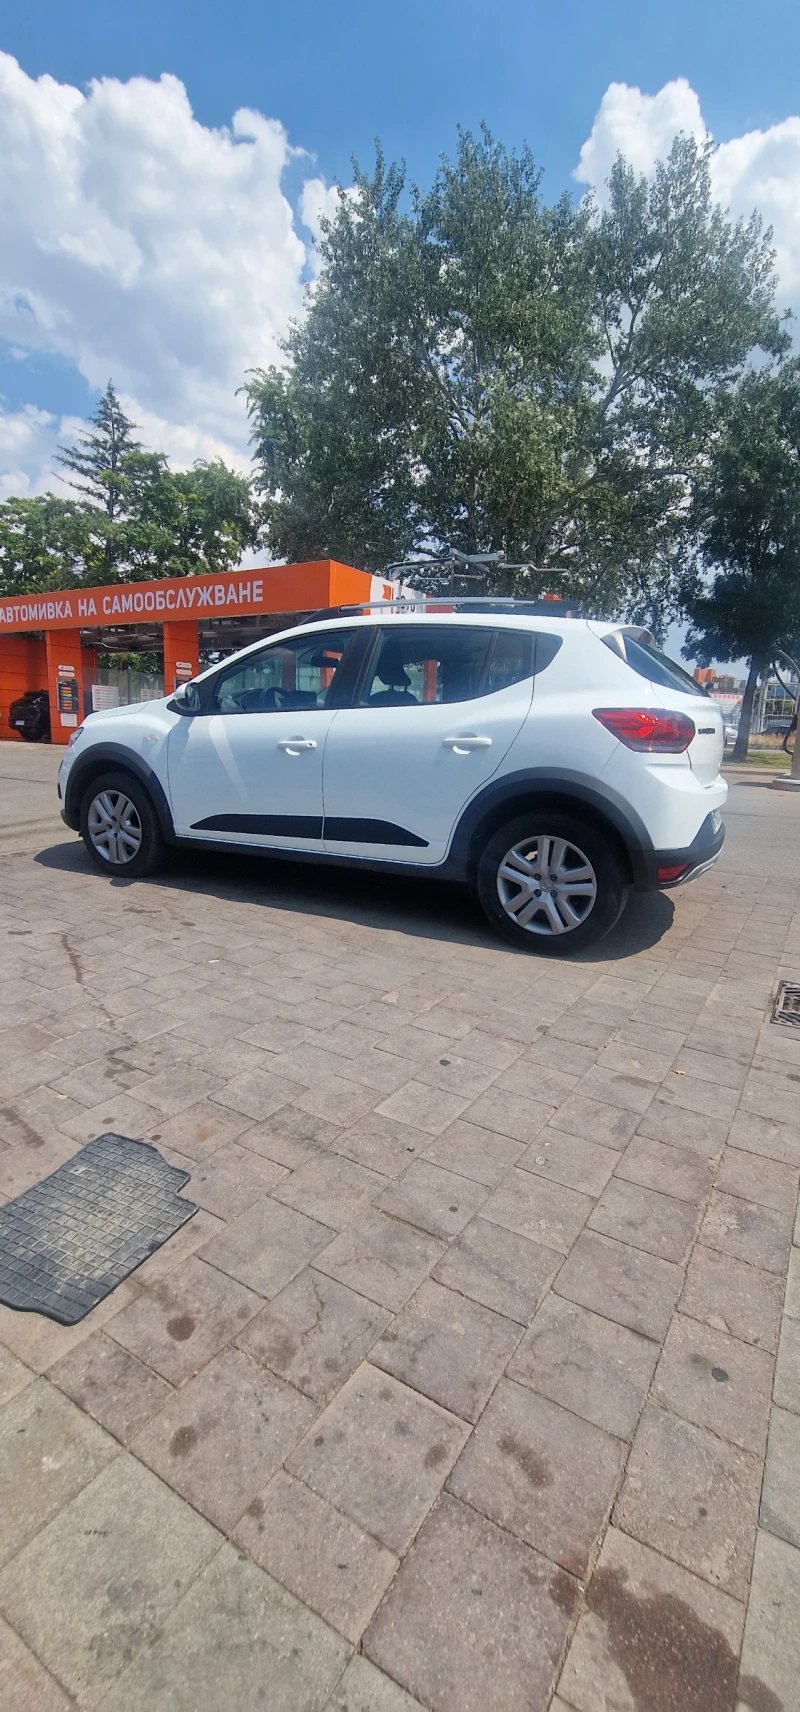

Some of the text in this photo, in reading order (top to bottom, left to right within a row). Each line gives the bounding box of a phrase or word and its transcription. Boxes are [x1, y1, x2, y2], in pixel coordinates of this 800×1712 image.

[0, 580, 264, 624] АВТОМИВКА НА САМООБСЛУЖВАНЕ
